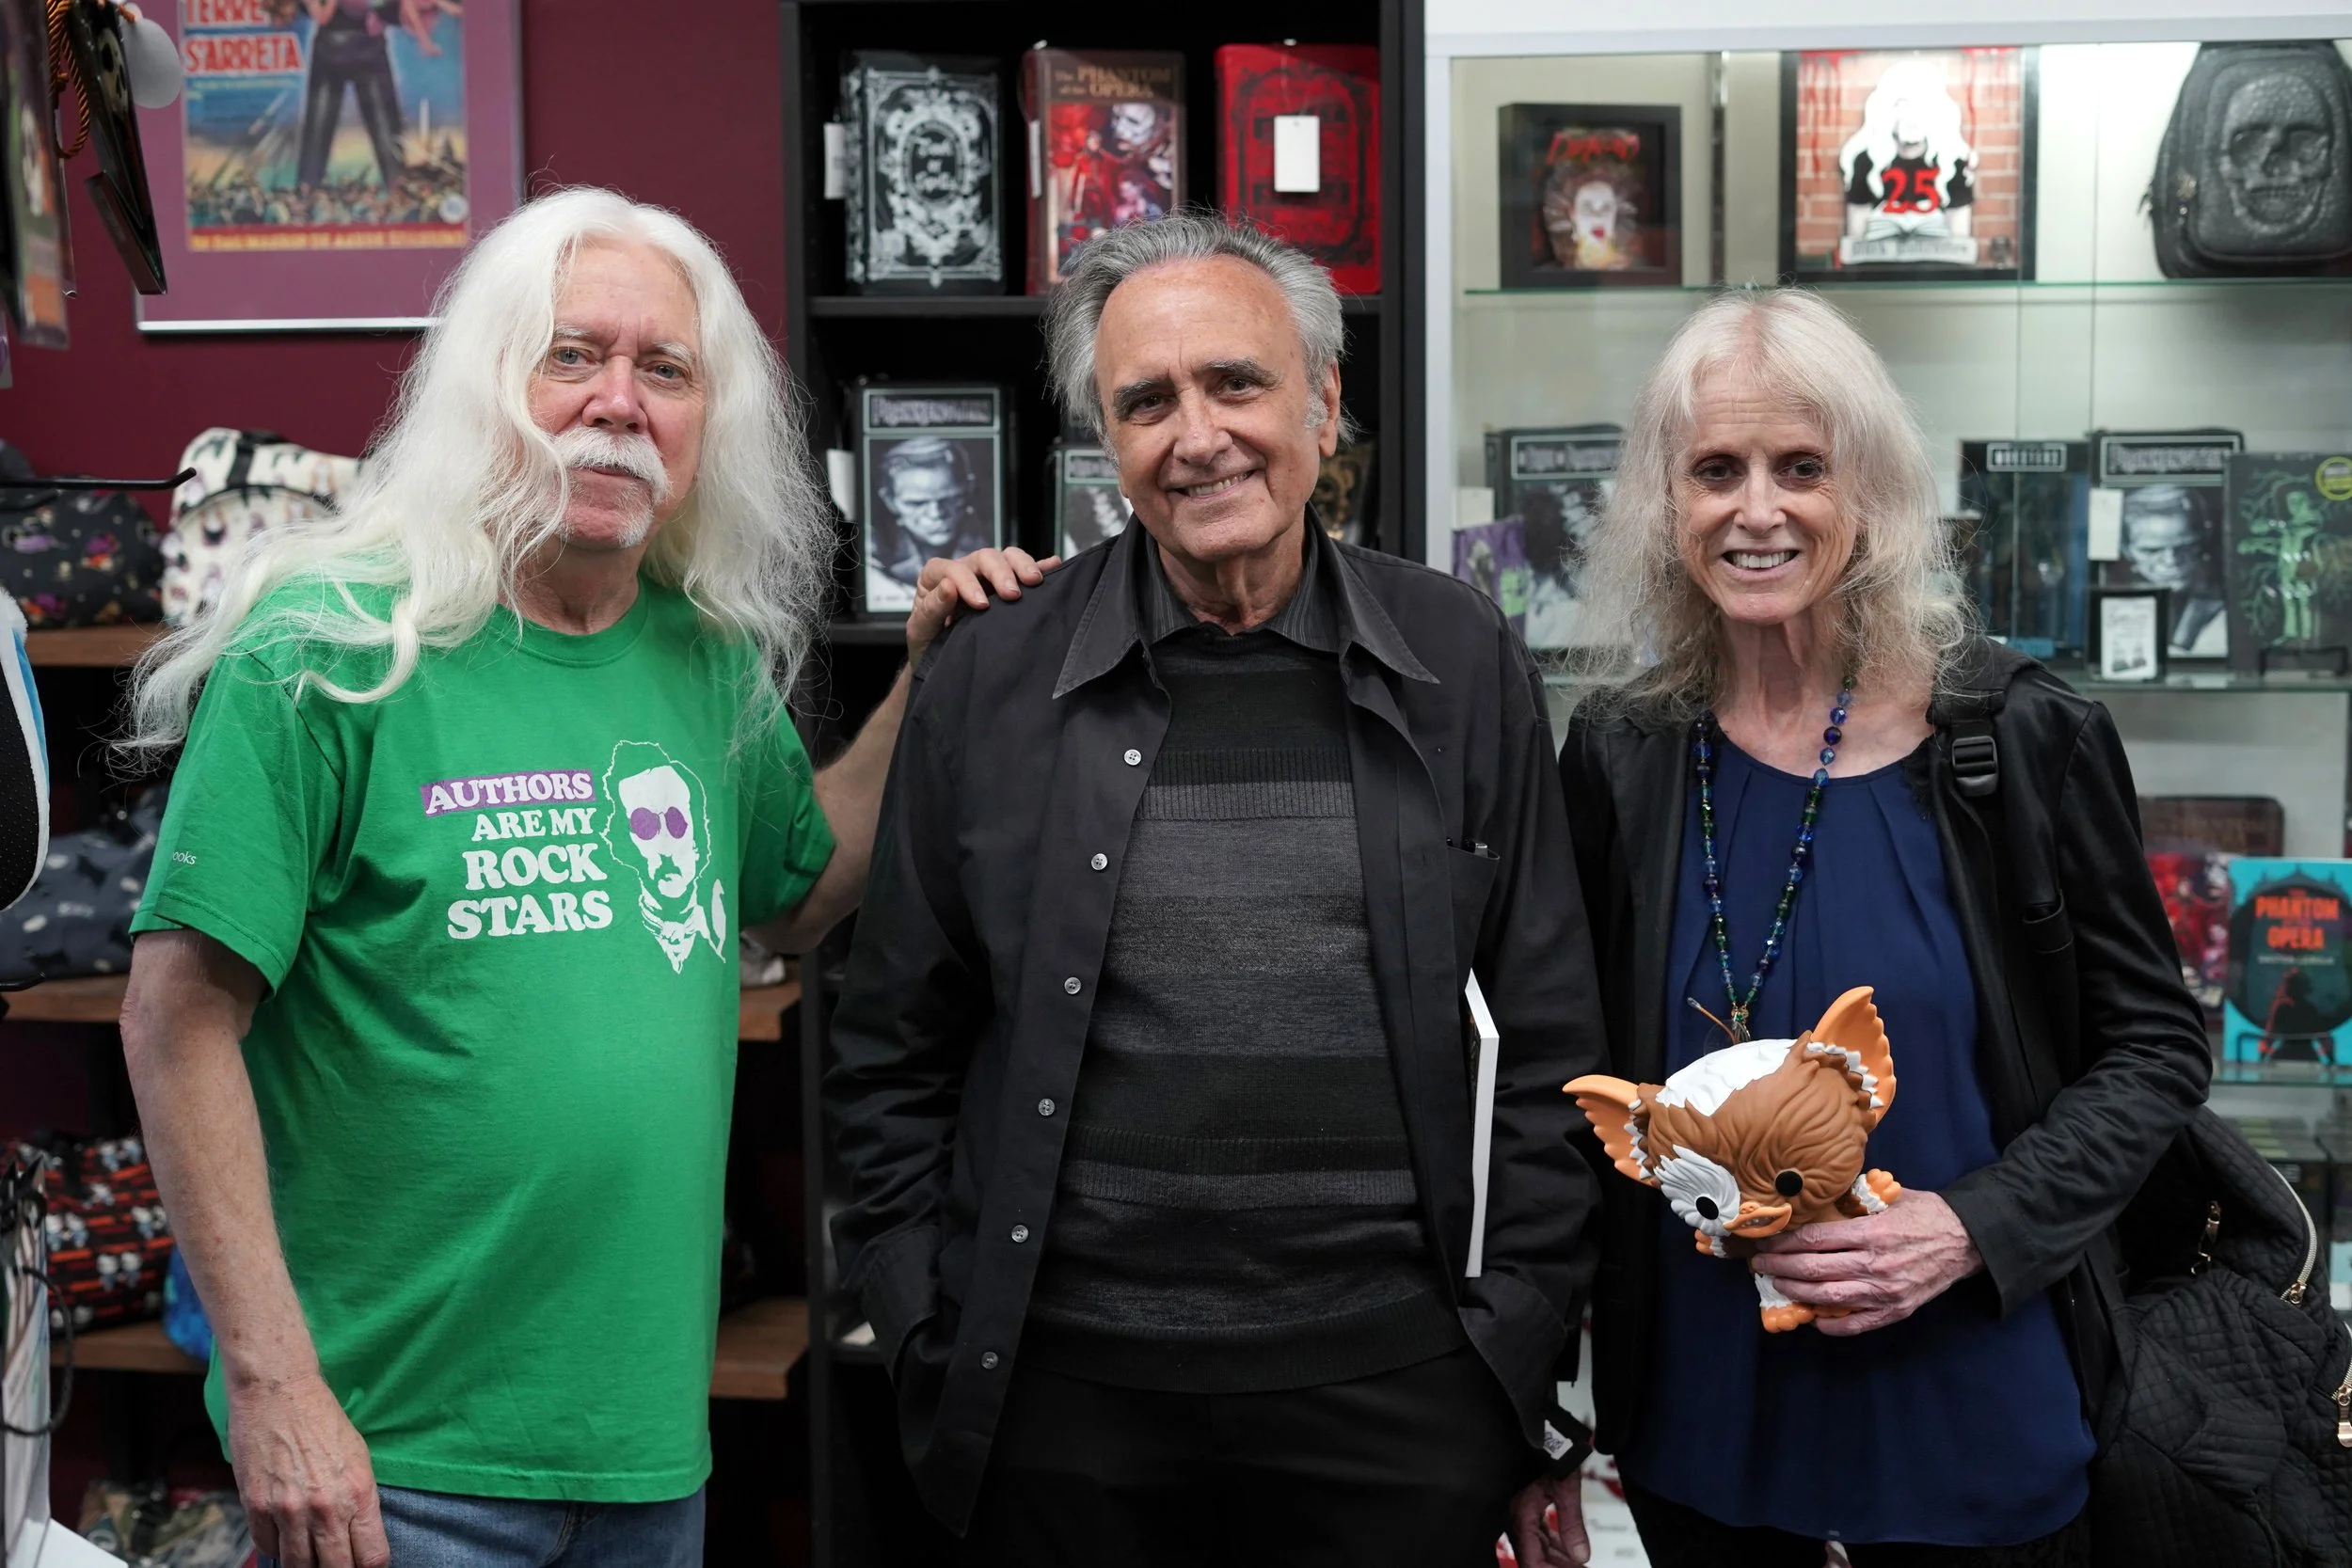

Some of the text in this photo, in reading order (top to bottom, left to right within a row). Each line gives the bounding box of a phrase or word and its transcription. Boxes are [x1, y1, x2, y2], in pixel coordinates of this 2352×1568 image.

[185, 35, 301, 72] S'ARRETA
[1077, 65, 1171, 86] PHANTOM
[1089, 82, 1154, 98] OPERA
[1881, 166, 1941, 214] 25
[425, 772, 594, 815] AUTHORS
[470, 807, 597, 842] ARE MY
[172, 850, 197, 865] ooks
[462, 843, 608, 891] ROCK
[447, 890, 613, 940] STARS
[2255, 895, 2339, 920] PHANTOM
[2266, 926, 2325, 950] OPERA
